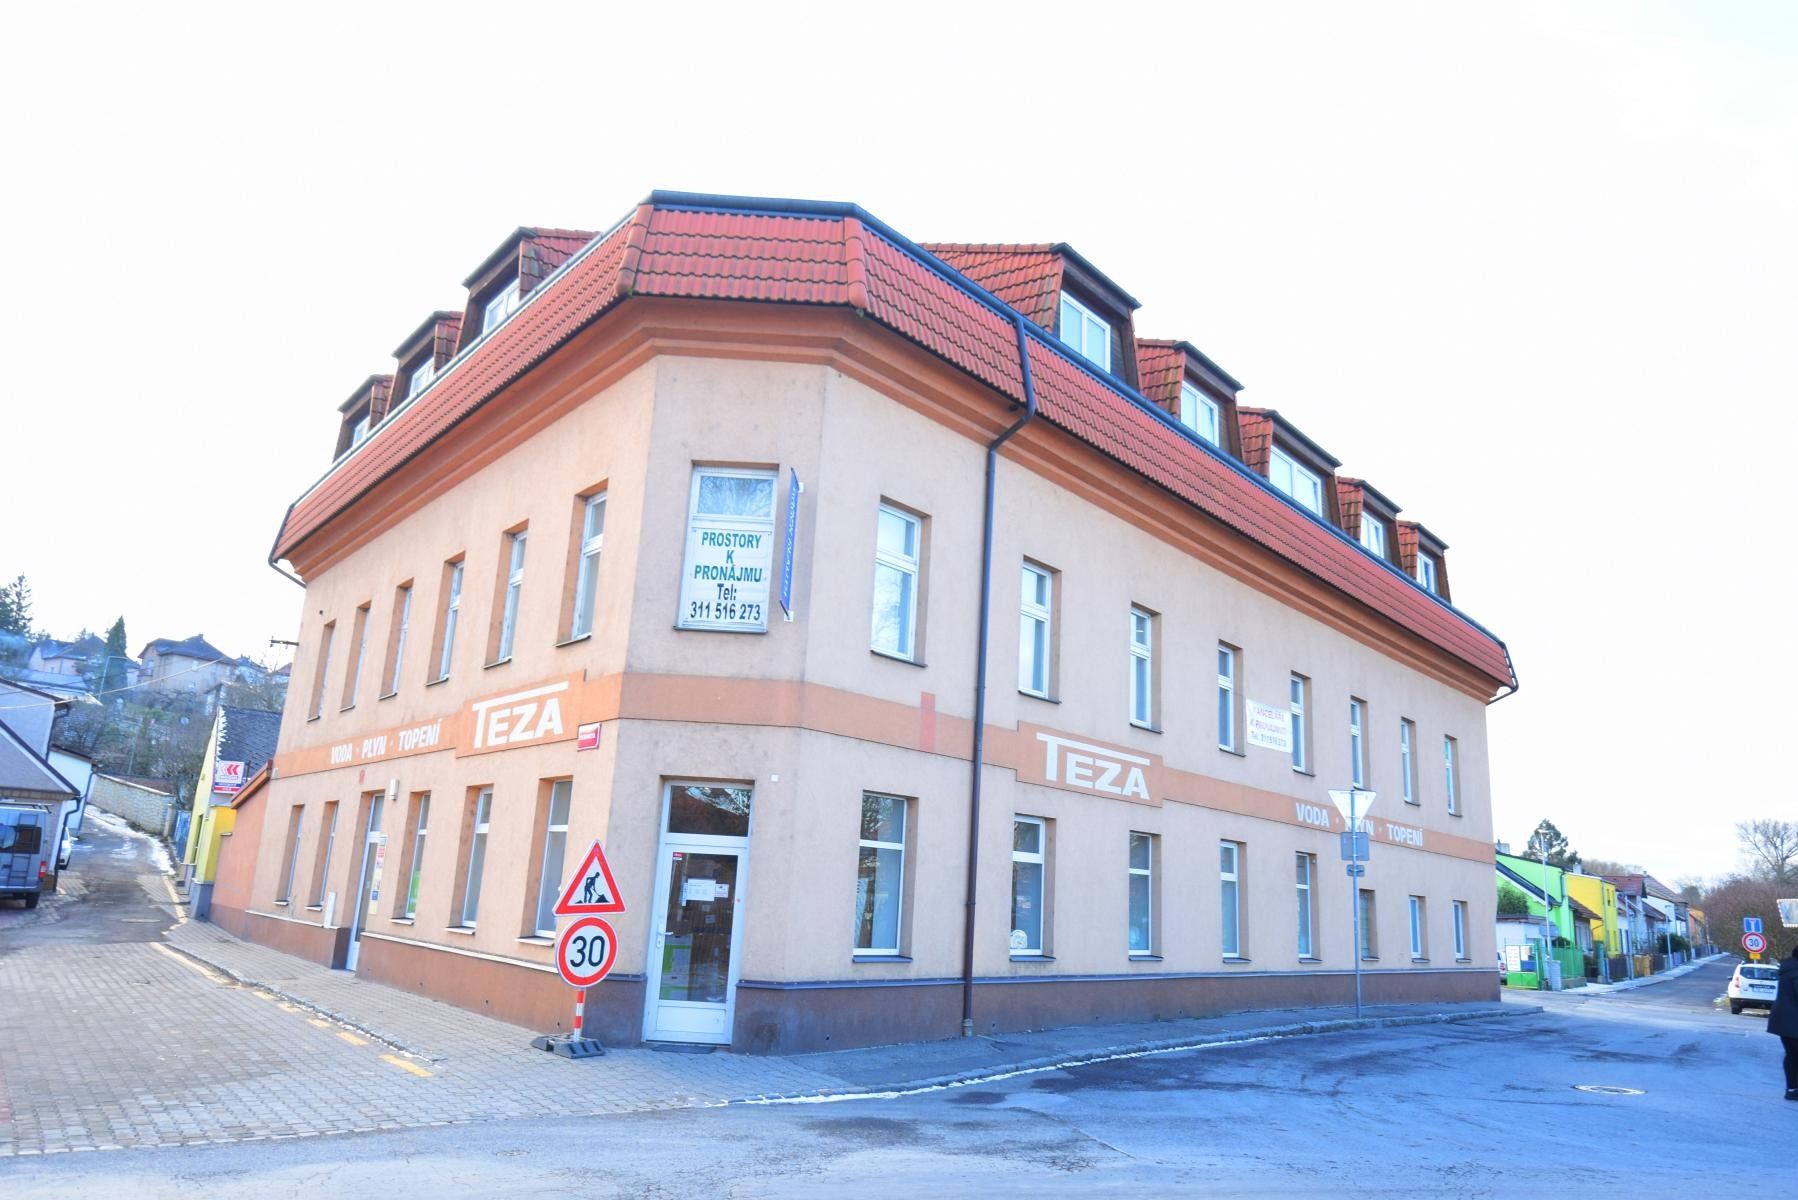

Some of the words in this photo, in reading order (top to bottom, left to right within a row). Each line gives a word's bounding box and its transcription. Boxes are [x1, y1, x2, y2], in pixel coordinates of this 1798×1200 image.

[702, 532, 762, 549] PROSTORY
[726, 549, 735, 564] K
[694, 564, 763, 582] PRONÁJMU
[717, 583, 737, 601] Tel:
[690, 601, 710, 619] 311
[715, 602, 736, 620] 516
[739, 603, 761, 621] 273
[472, 680, 569, 749] TEZA
[330, 743, 353, 764] VODA
[361, 735, 387, 759] PLYN
[398, 718, 443, 752] TOPENÍ
[1036, 732, 1151, 800] TEZA
[1295, 802, 1330, 828] VODA
[1386, 823, 1424, 847] TOPENÍ
[570, 935, 605, 967] 30
[1748, 938, 1760, 947] 30
